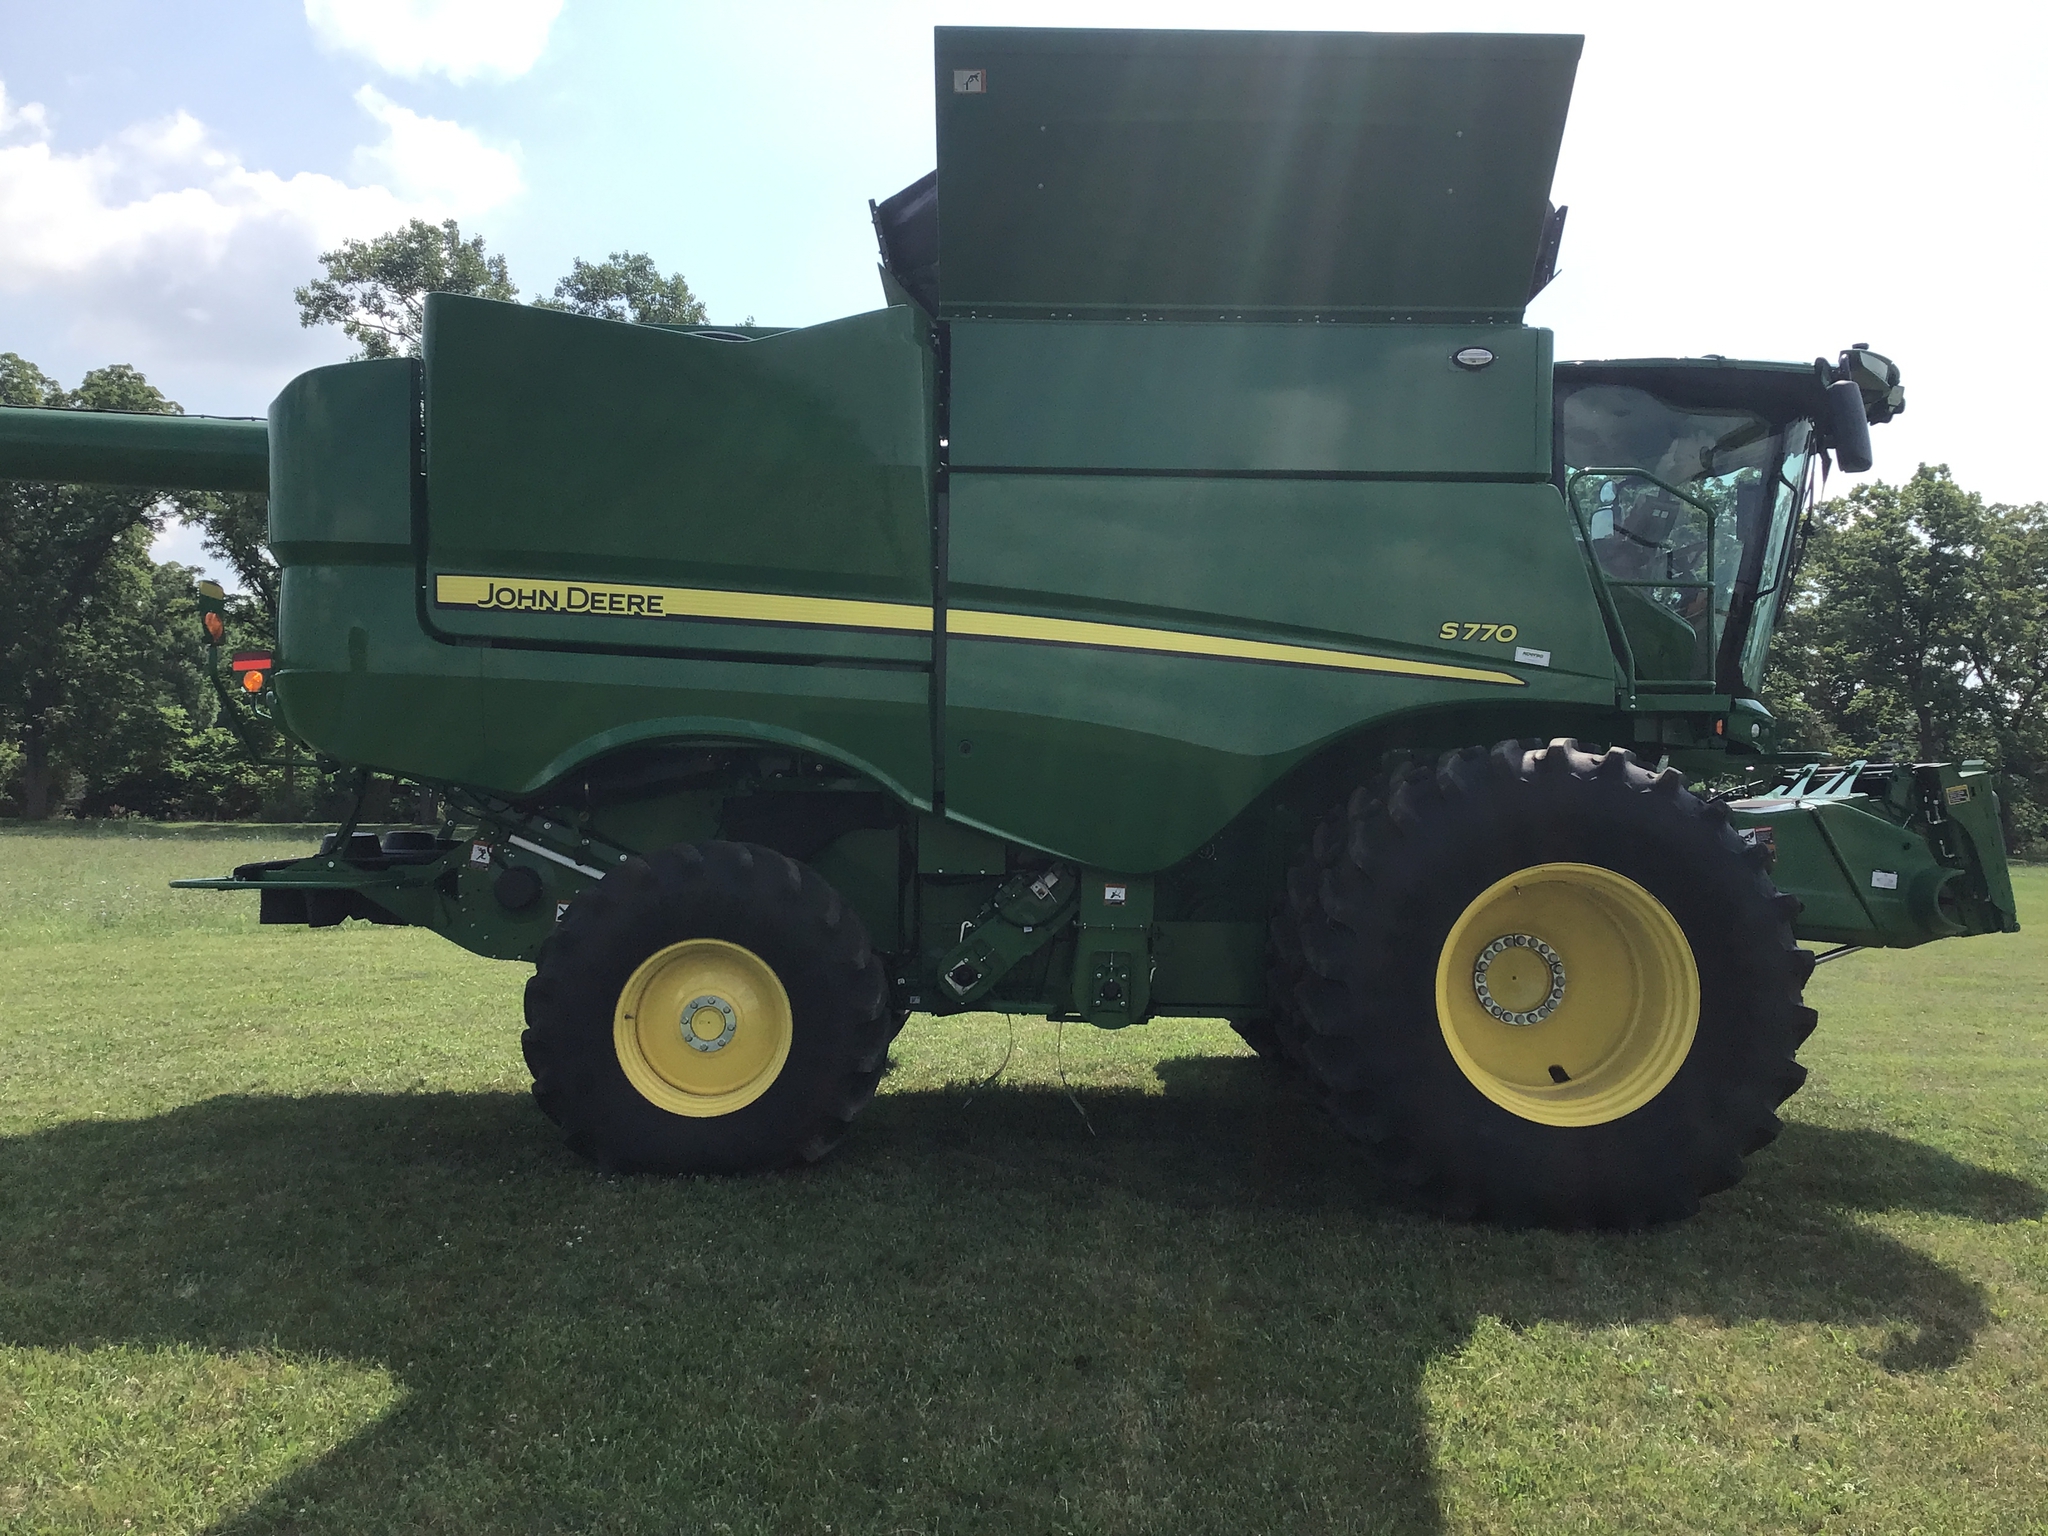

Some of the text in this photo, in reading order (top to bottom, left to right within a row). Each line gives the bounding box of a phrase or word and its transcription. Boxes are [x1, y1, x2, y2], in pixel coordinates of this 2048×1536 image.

[477, 583, 664, 614] JOHN DEERE
[1440, 622, 1518, 642] S770
